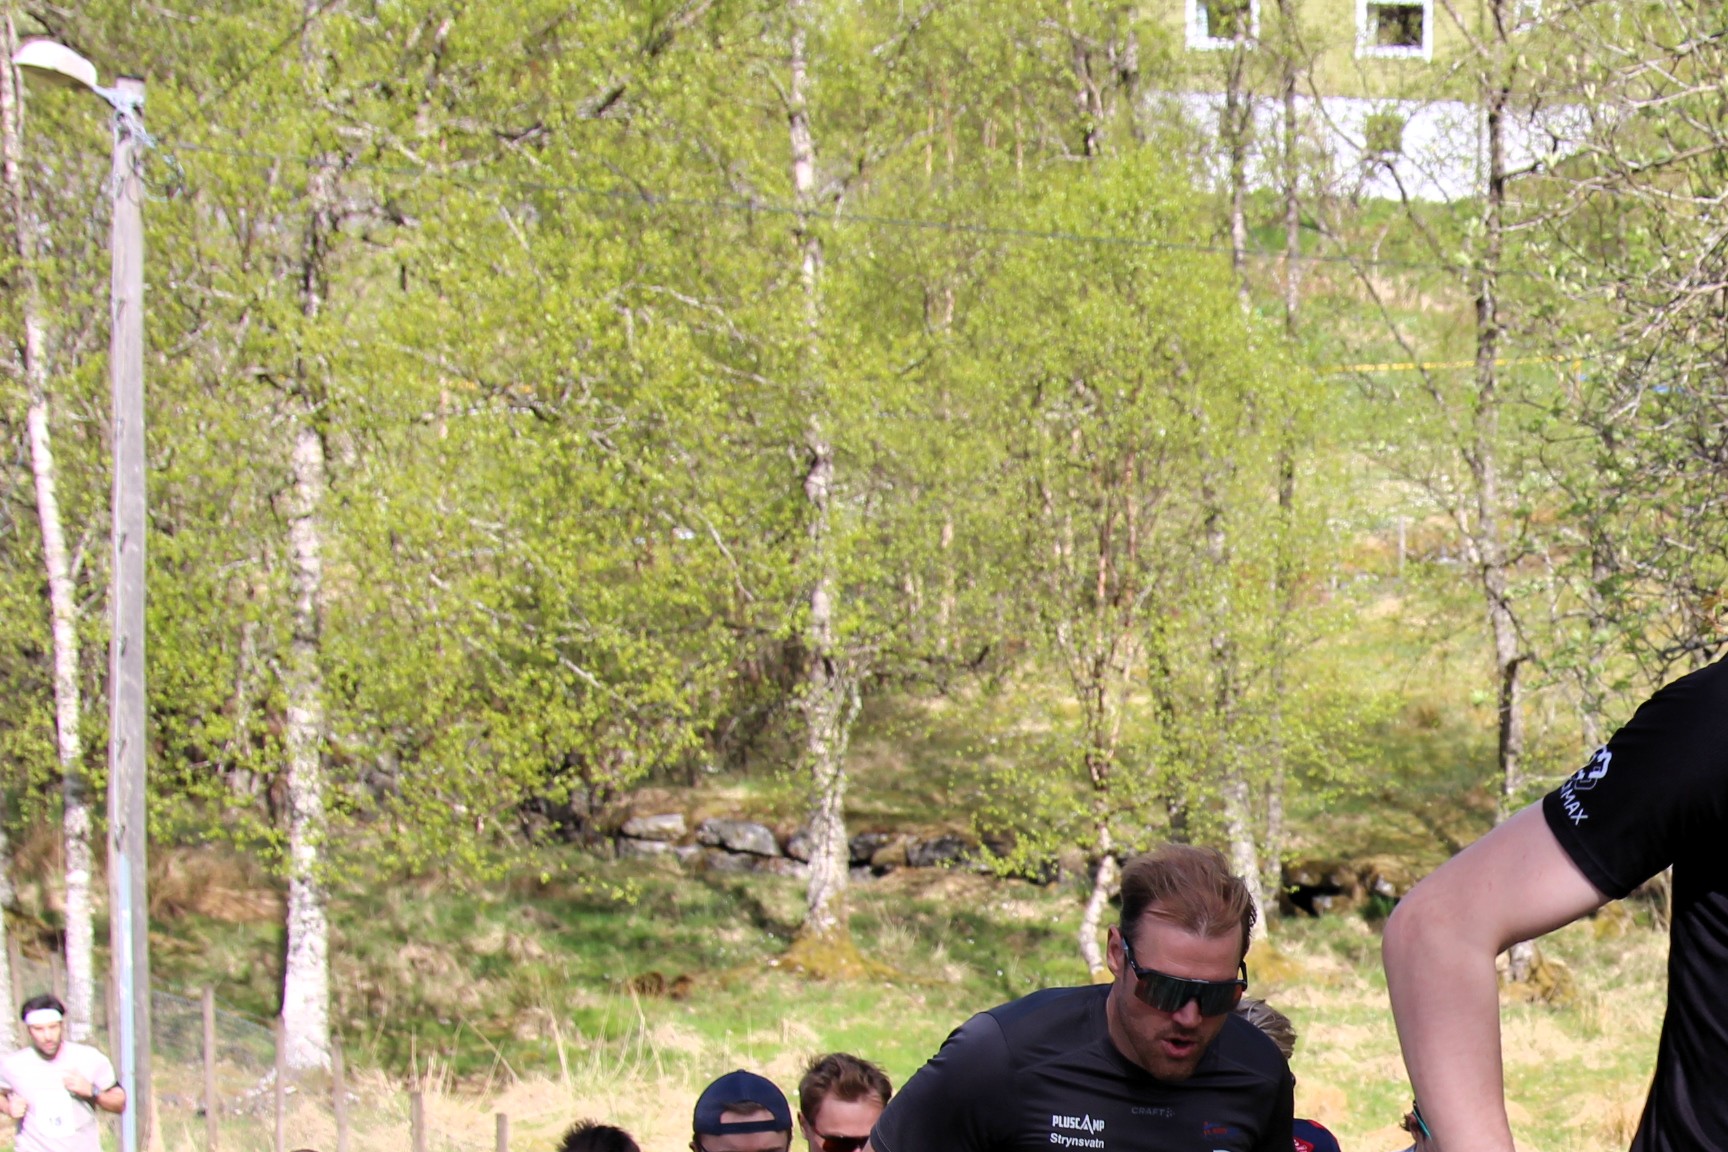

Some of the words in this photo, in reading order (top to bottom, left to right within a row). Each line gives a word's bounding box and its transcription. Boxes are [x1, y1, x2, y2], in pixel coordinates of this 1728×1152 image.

[1131, 1106, 1165, 1118] CRAFT
[1052, 1113, 1105, 1135] PLUSCAMP
[1050, 1132, 1104, 1149] Strynsvatn
